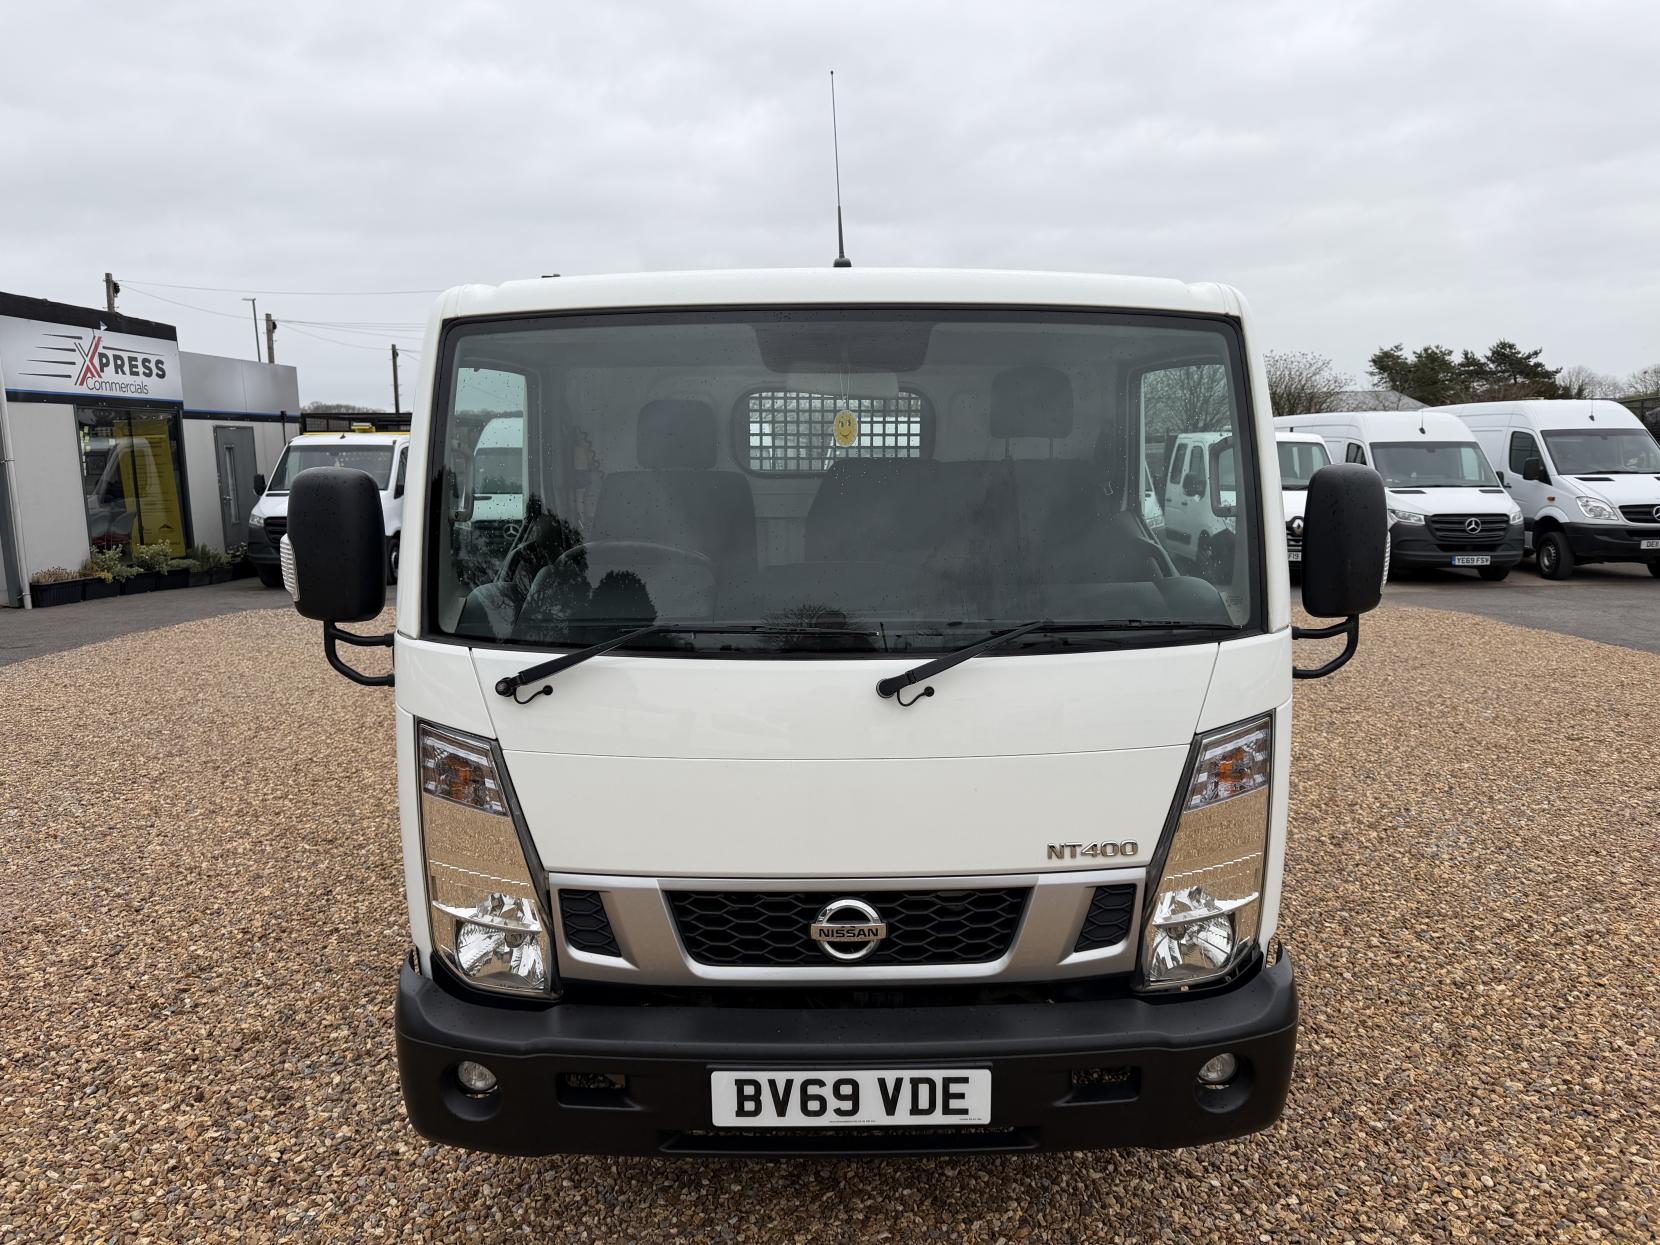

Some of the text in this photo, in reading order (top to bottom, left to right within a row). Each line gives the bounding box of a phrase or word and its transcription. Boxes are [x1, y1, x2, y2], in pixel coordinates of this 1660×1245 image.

[74, 336, 166, 387] XPRESS
[85, 376, 149, 395] Commercials
[1047, 840, 1138, 860] NT400
[818, 928, 879, 938] NISSAN
[734, 1076, 969, 1117] BV69 VDE
